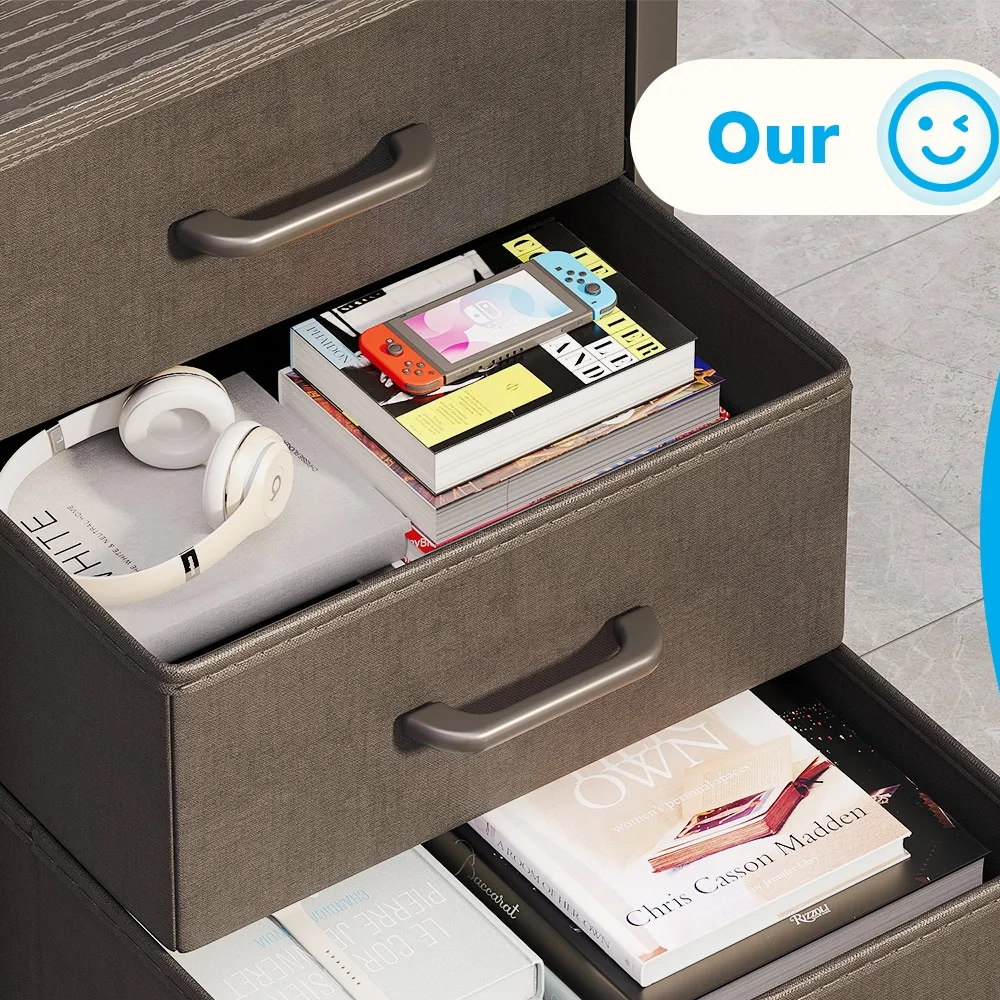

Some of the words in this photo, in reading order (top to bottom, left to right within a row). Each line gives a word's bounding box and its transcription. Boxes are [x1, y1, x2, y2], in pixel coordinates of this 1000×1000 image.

[305, 324, 353, 365] PHAIDON
[554, 340, 607, 383] AND
[595, 340, 635, 370] LE
[574, 722, 729, 809] OWN
[612, 805, 665, 833] women's
[665, 781, 713, 811] personal
[715, 764, 752, 786] spaces
[455, 839, 520, 920] Baccarat
[626, 893, 692, 927] Chris
[694, 853, 774, 895] Casson
[774, 807, 867, 856] Madden
[353, 882, 447, 936] PIERRE
[505, 848, 540, 884] ROOM
[542, 880, 557, 898] OF
[558, 896, 580, 920] HER
[583, 920, 611, 949] OWN
[409, 918, 451, 946] LE
